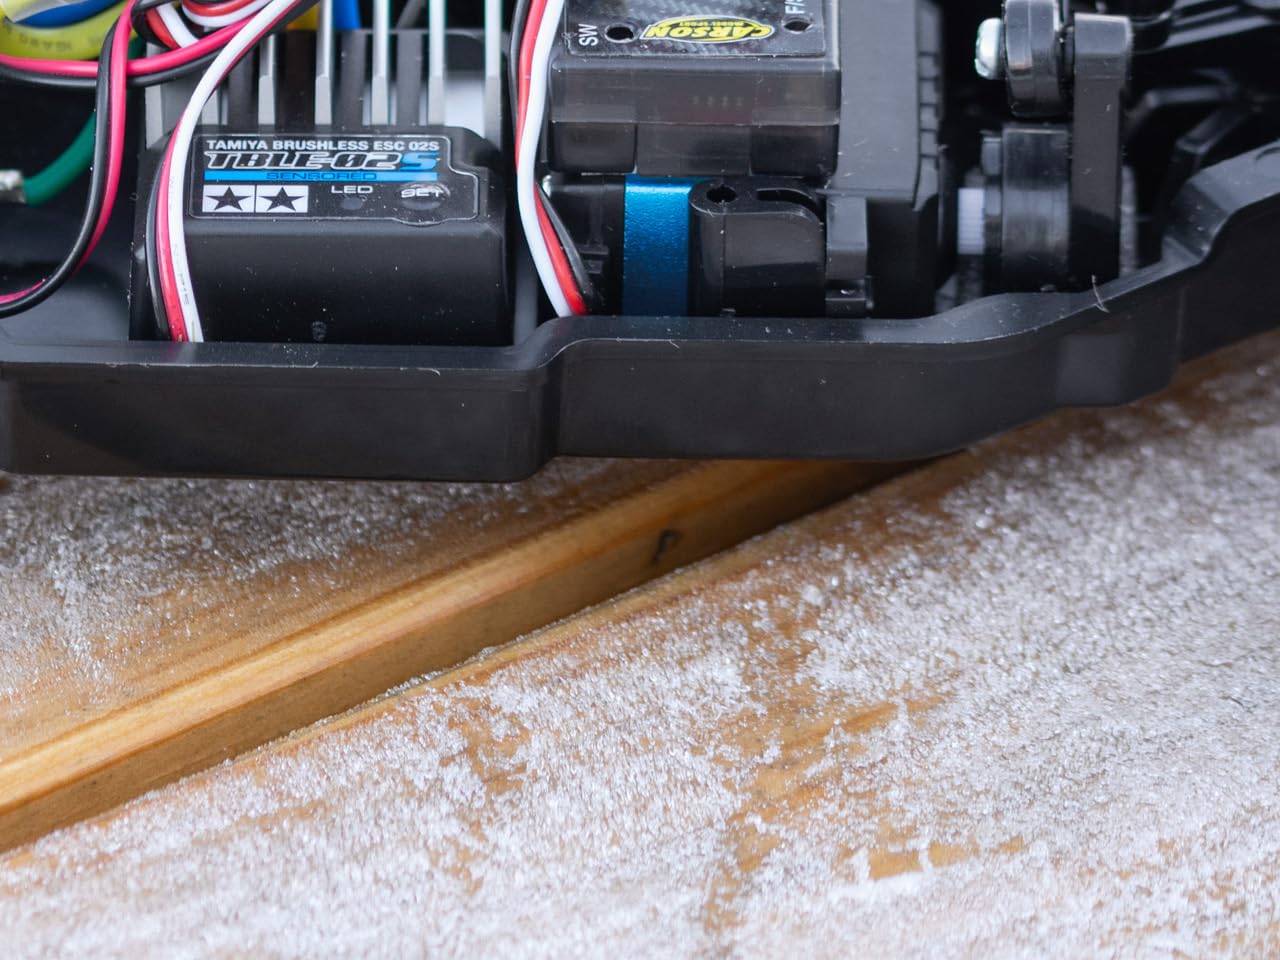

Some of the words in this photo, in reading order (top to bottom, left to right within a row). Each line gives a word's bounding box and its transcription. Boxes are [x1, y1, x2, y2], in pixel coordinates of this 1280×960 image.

[578, 23, 598, 46] SW
[644, 22, 773, 40] CARSON
[207, 140, 267, 150] TAMIYA
[273, 140, 369, 150] BRUSHLESS
[373, 141, 405, 151] ESC
[409, 141, 440, 151] 02S
[204, 151, 440, 171] TBLE-02S
[266, 171, 377, 181] SENSORED
[331, 185, 373, 194] LED
[401, 188, 442, 198] SET
